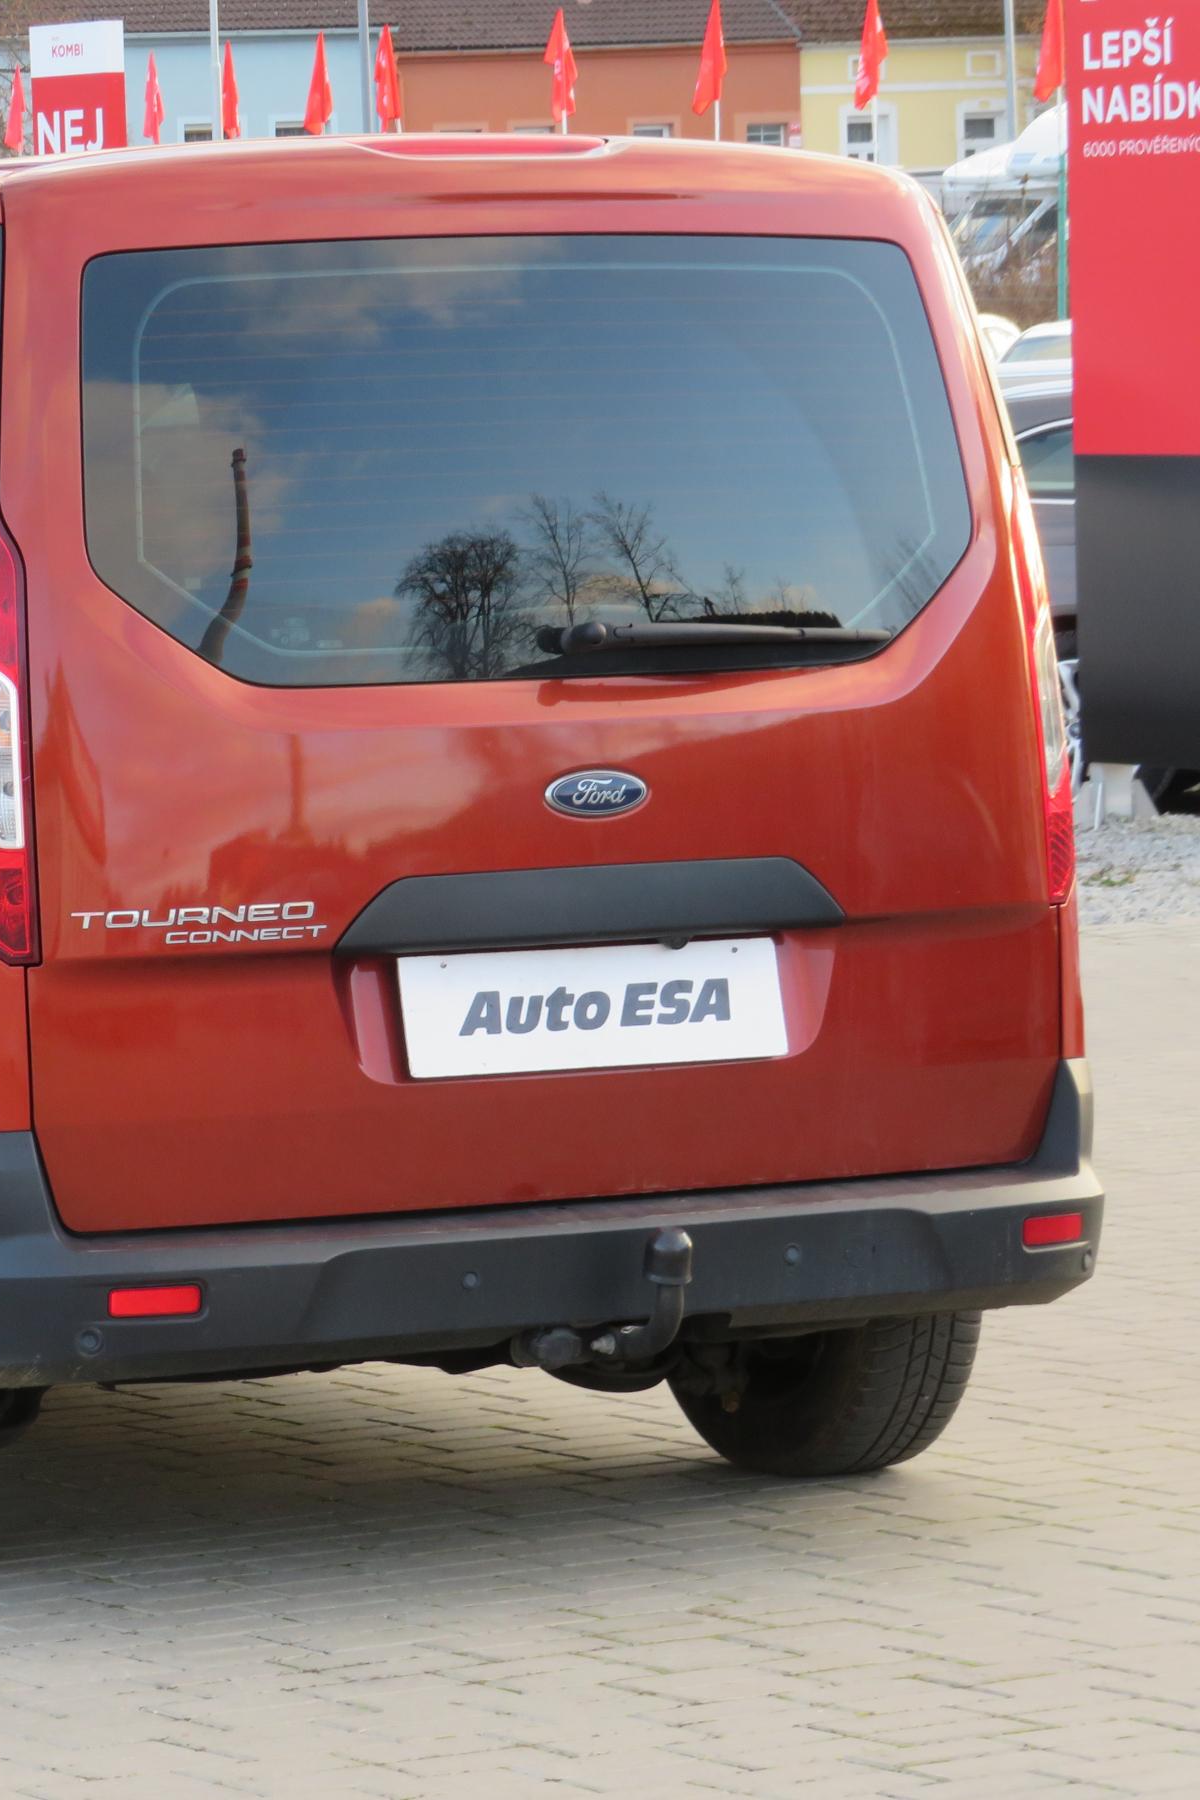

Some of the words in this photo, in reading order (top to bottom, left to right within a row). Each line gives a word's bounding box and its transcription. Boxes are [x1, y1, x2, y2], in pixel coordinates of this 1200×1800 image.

[51, 43, 84, 57] KOMBI
[1083, 16, 1174, 70] LEPŠÍ
[37, 107, 104, 156] NEJ
[1083, 141, 1116, 158] 6000
[572, 778, 626, 805] Ford
[71, 901, 315, 929] TOURNEO
[166, 924, 327, 944] CONNECT
[459, 986, 611, 1037] Auto
[620, 978, 731, 1027] ESA
